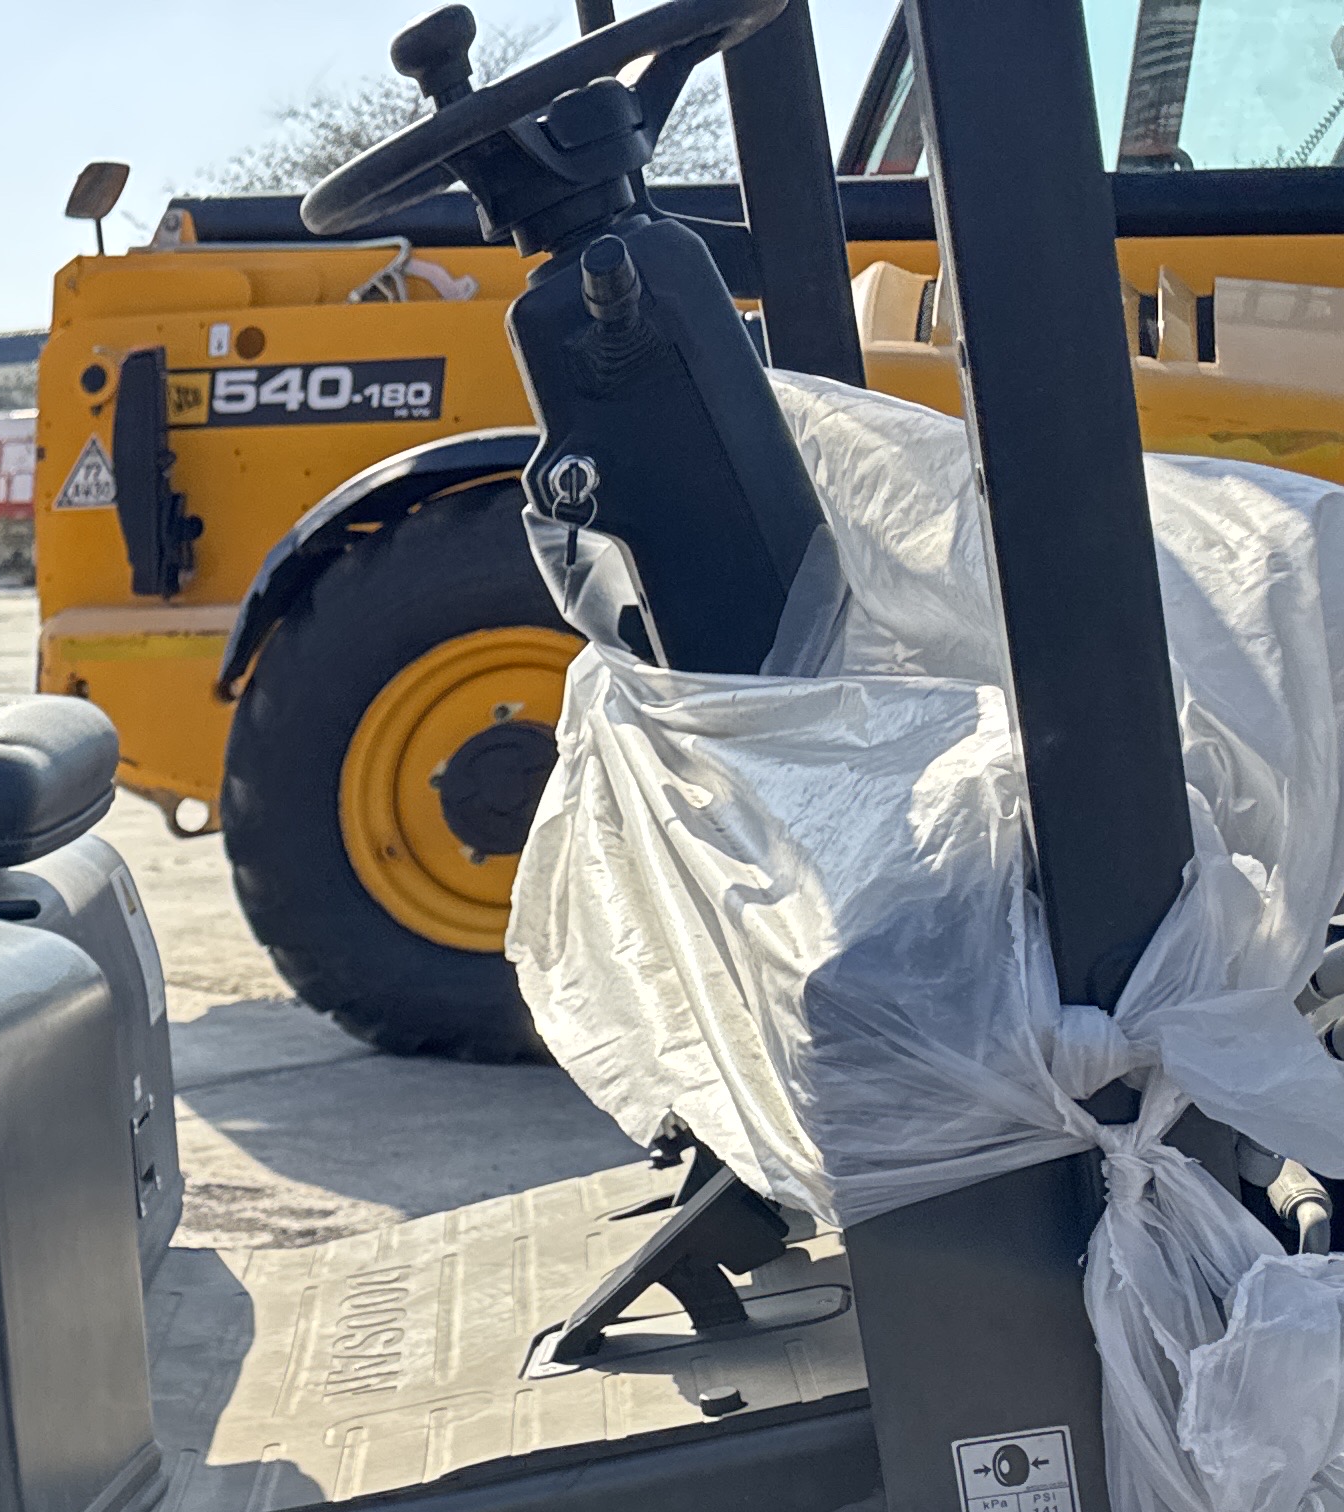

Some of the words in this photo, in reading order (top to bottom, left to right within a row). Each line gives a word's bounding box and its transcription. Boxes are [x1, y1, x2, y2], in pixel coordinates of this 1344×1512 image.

[322, 1264, 413, 1400] DOOSAN
[1033, 1492, 1056, 1504] PSI
[983, 1499, 1008, 1511] kPa
